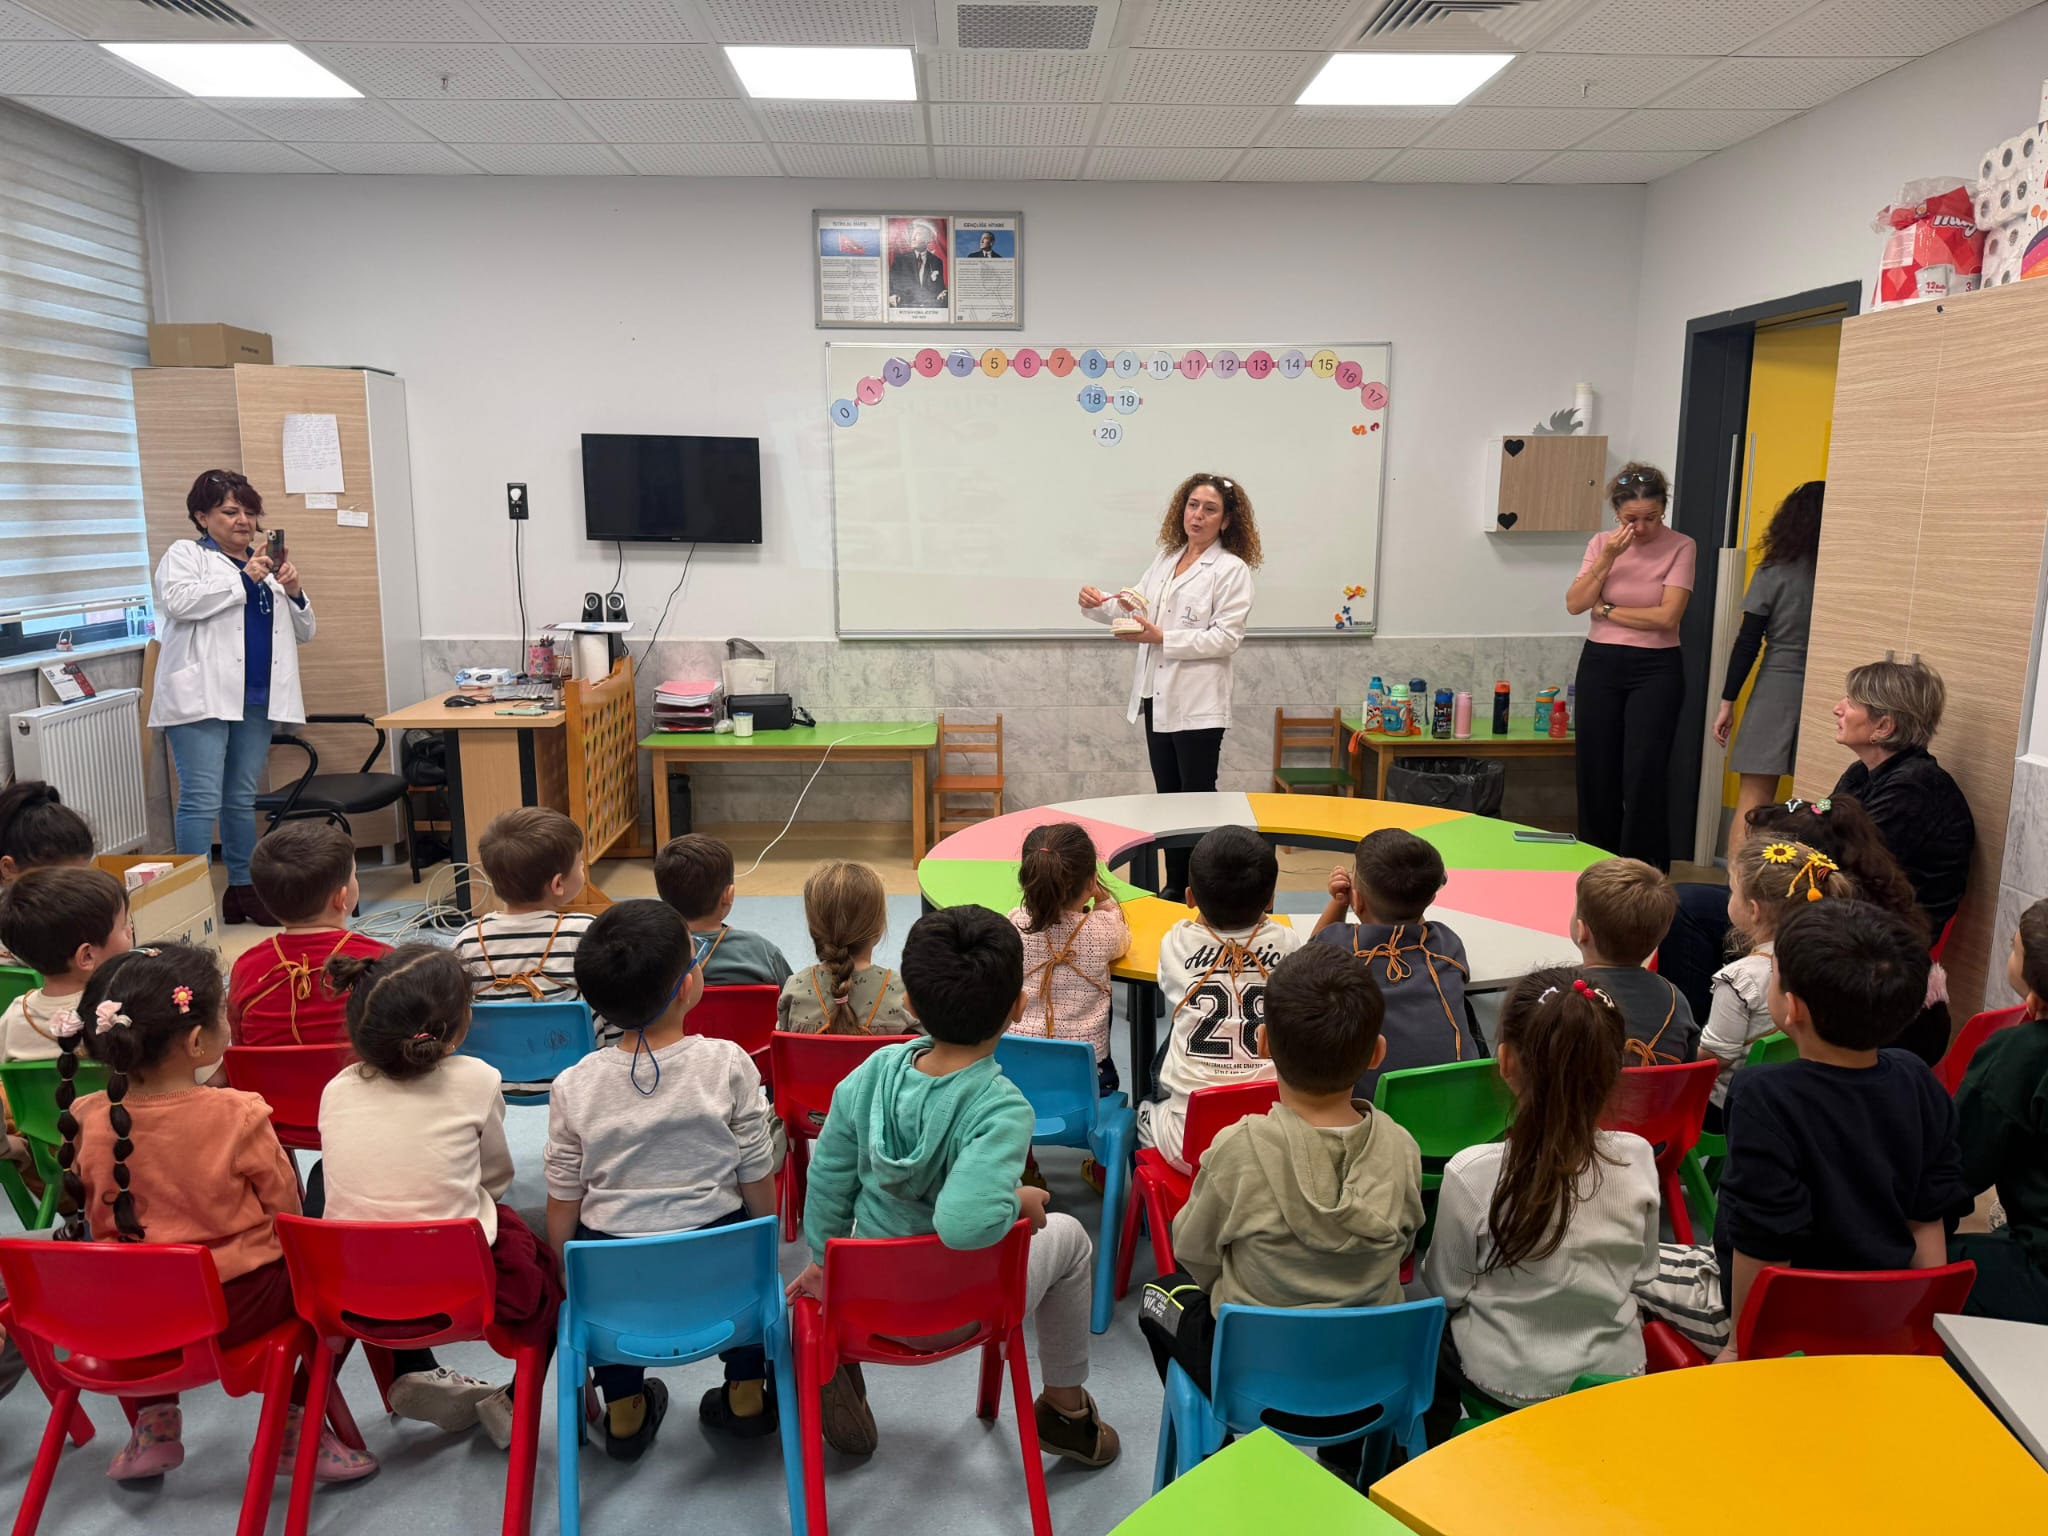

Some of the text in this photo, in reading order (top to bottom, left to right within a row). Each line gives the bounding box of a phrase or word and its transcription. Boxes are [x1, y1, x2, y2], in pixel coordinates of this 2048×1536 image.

[1925, 281, 1936, 290] 12
[1153, 360, 1169, 372] 10
[1187, 359, 1201, 372] 11
[1219, 359, 1235, 371] 12
[1253, 359, 1268, 372] 13
[1285, 358, 1300, 370] 14
[1318, 358, 1334, 371] 15
[1342, 368, 1357, 384] 16
[1367, 388, 1384, 403] 17
[1086, 393, 1135, 407] 18 19
[1101, 428, 1117, 440] 20
[1185, 943, 1281, 970] Athetic
